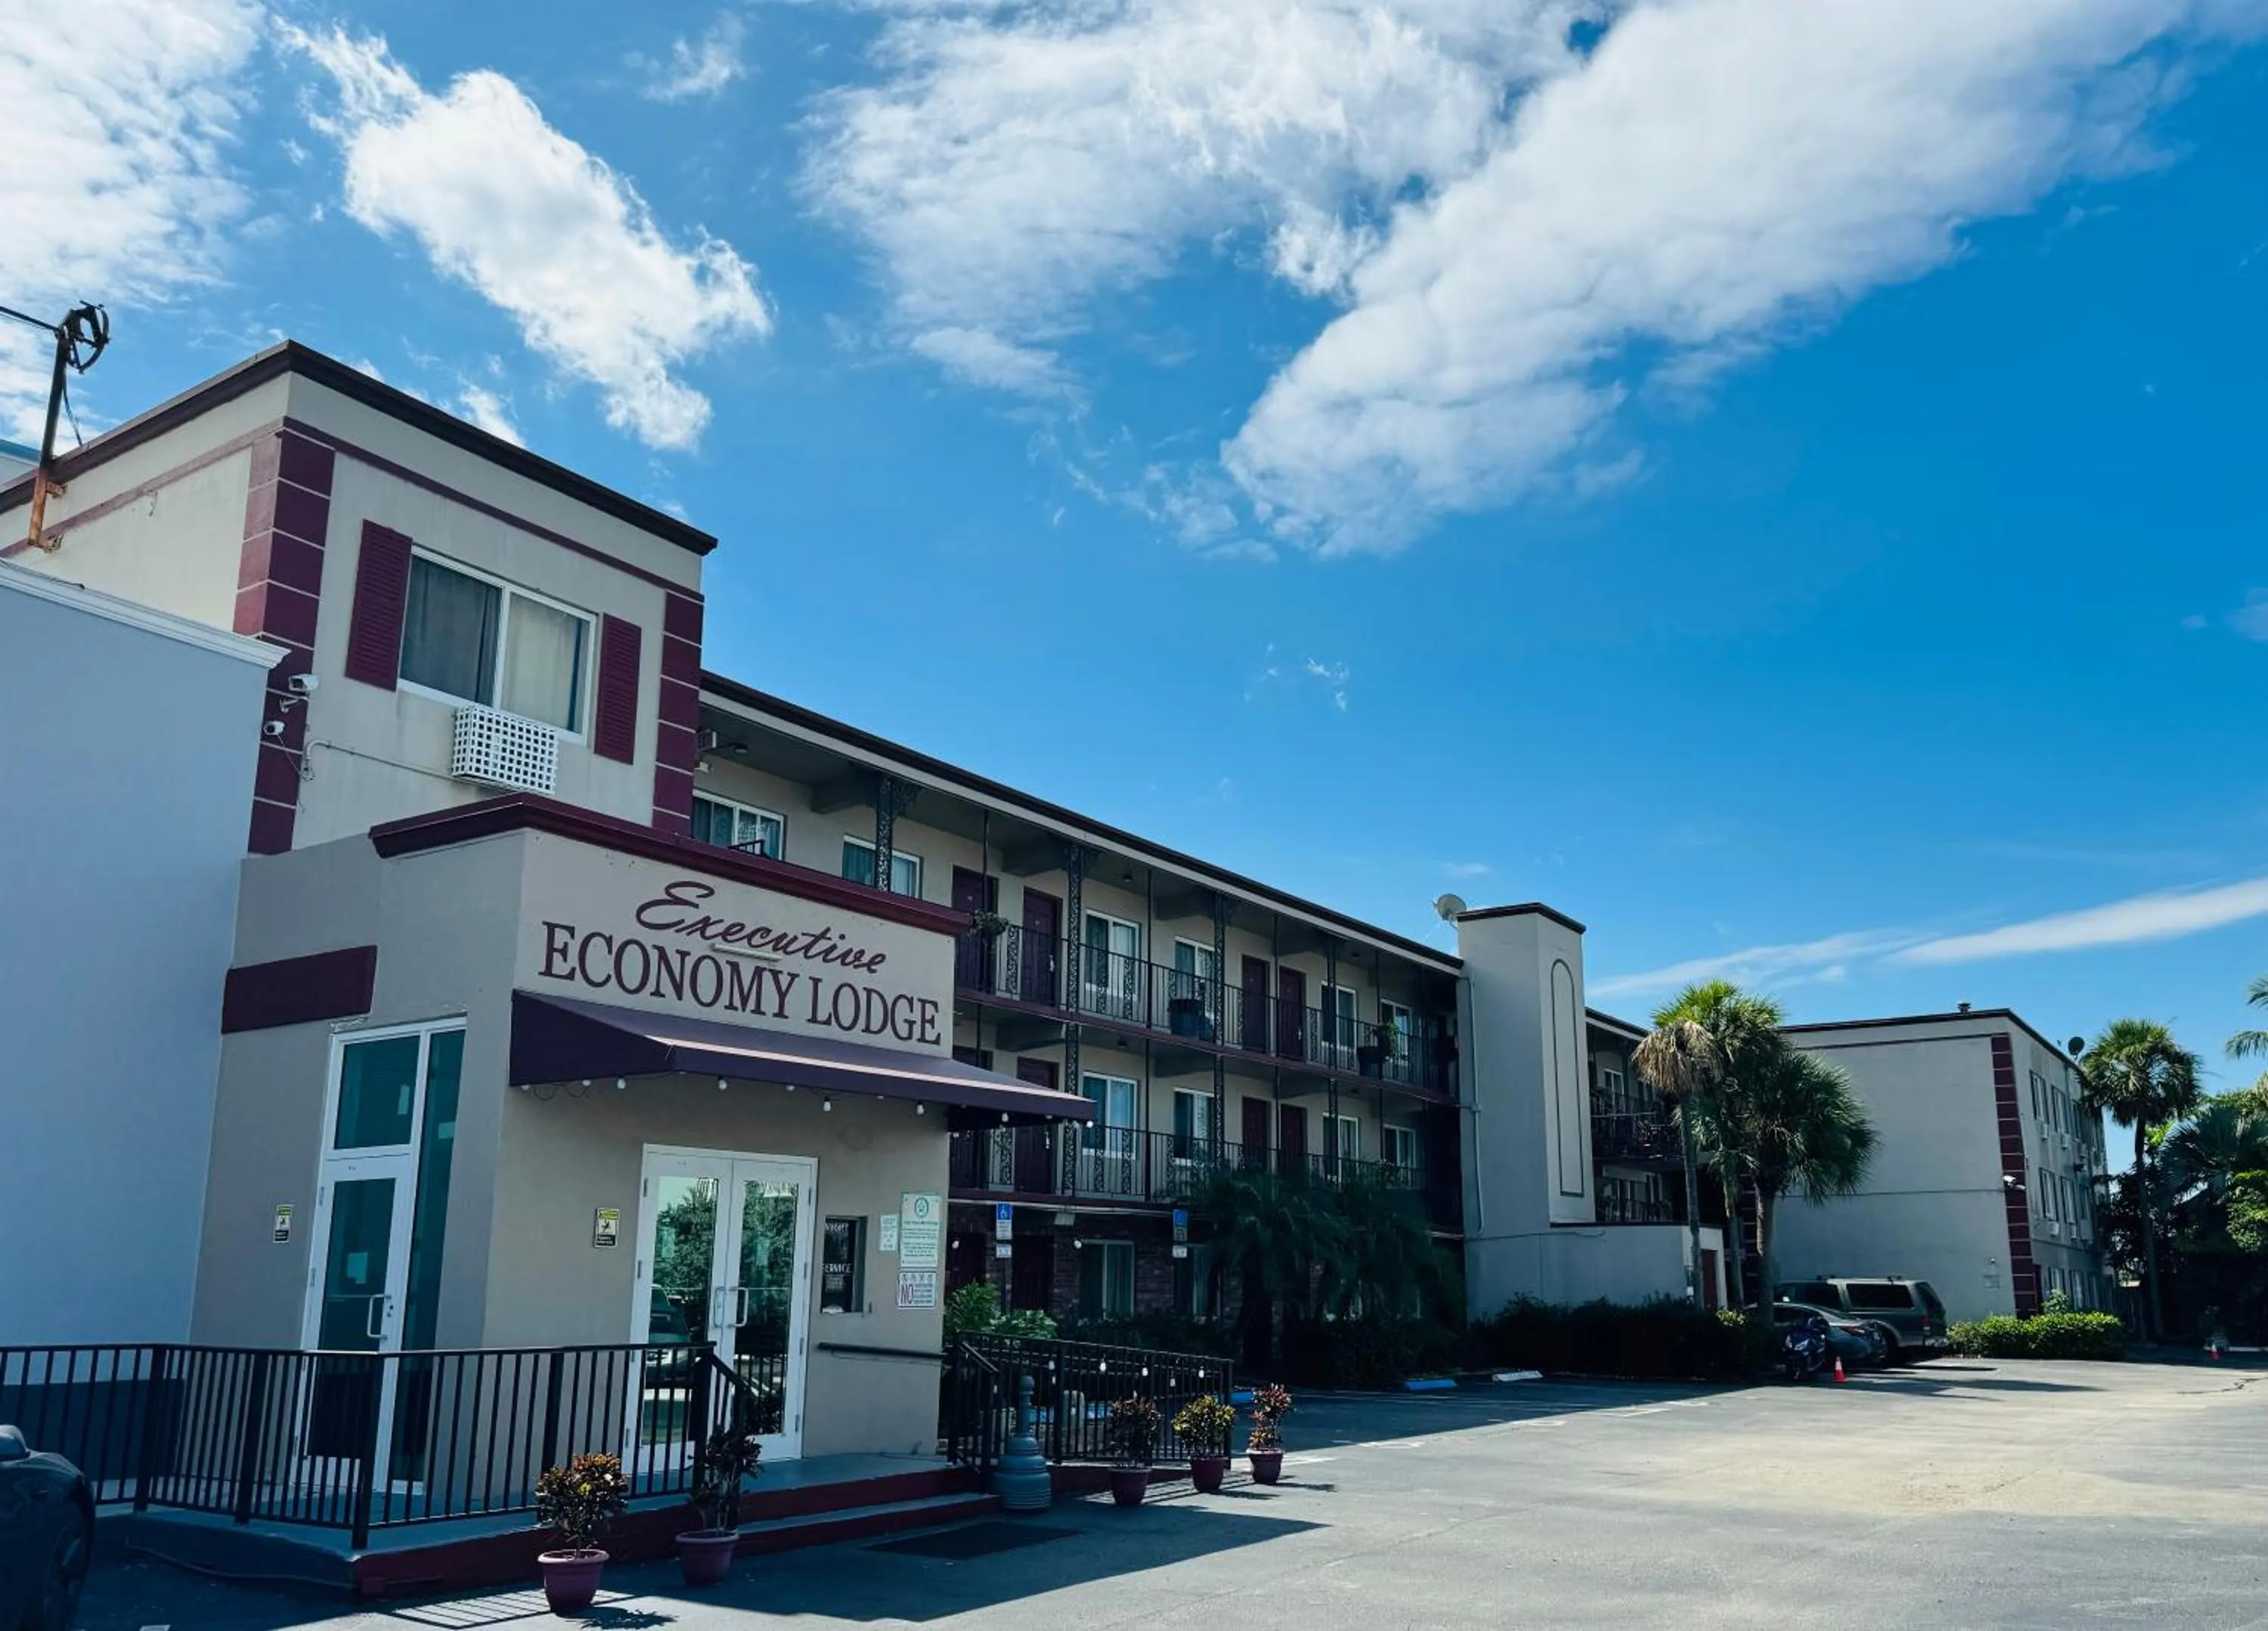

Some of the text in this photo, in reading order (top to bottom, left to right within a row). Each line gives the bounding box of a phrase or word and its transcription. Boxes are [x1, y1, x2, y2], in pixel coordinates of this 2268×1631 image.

[637, 880, 886, 973] Executive
[538, 920, 941, 1045] ECONOMY LODGE
